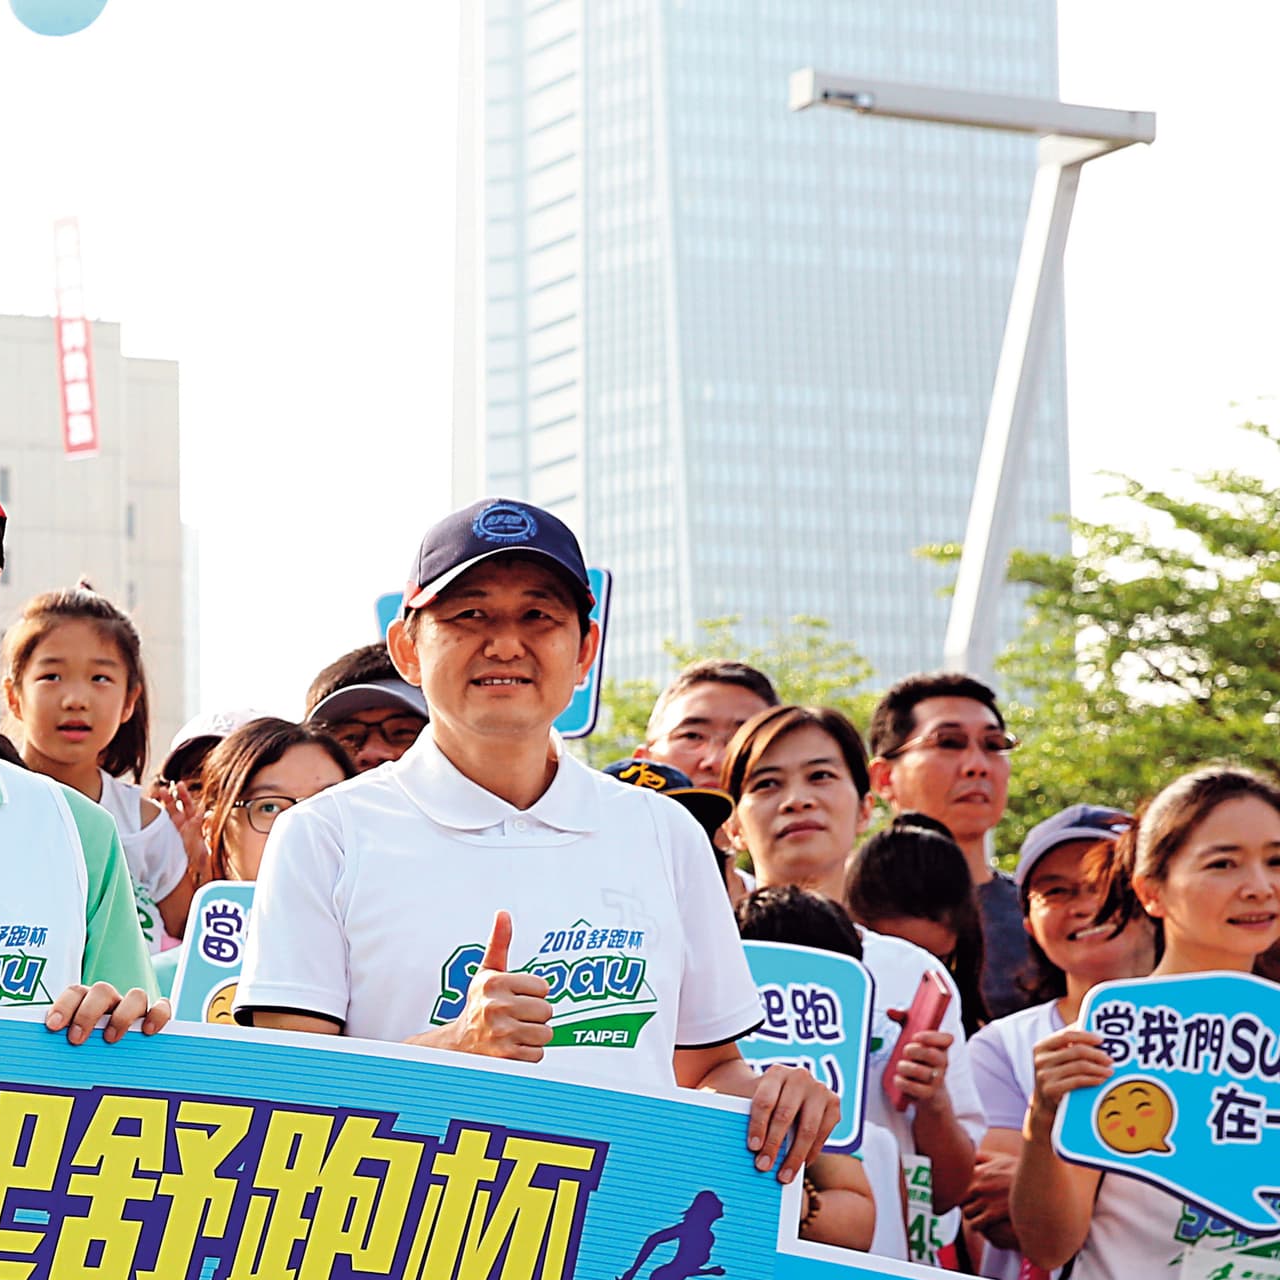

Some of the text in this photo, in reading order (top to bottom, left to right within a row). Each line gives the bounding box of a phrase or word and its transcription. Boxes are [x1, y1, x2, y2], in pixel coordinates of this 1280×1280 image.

[540, 929, 644, 953] 2018 舒跑杯
[430, 945, 645, 1024] Spau
[573, 1030, 629, 1044] TAIPEI
